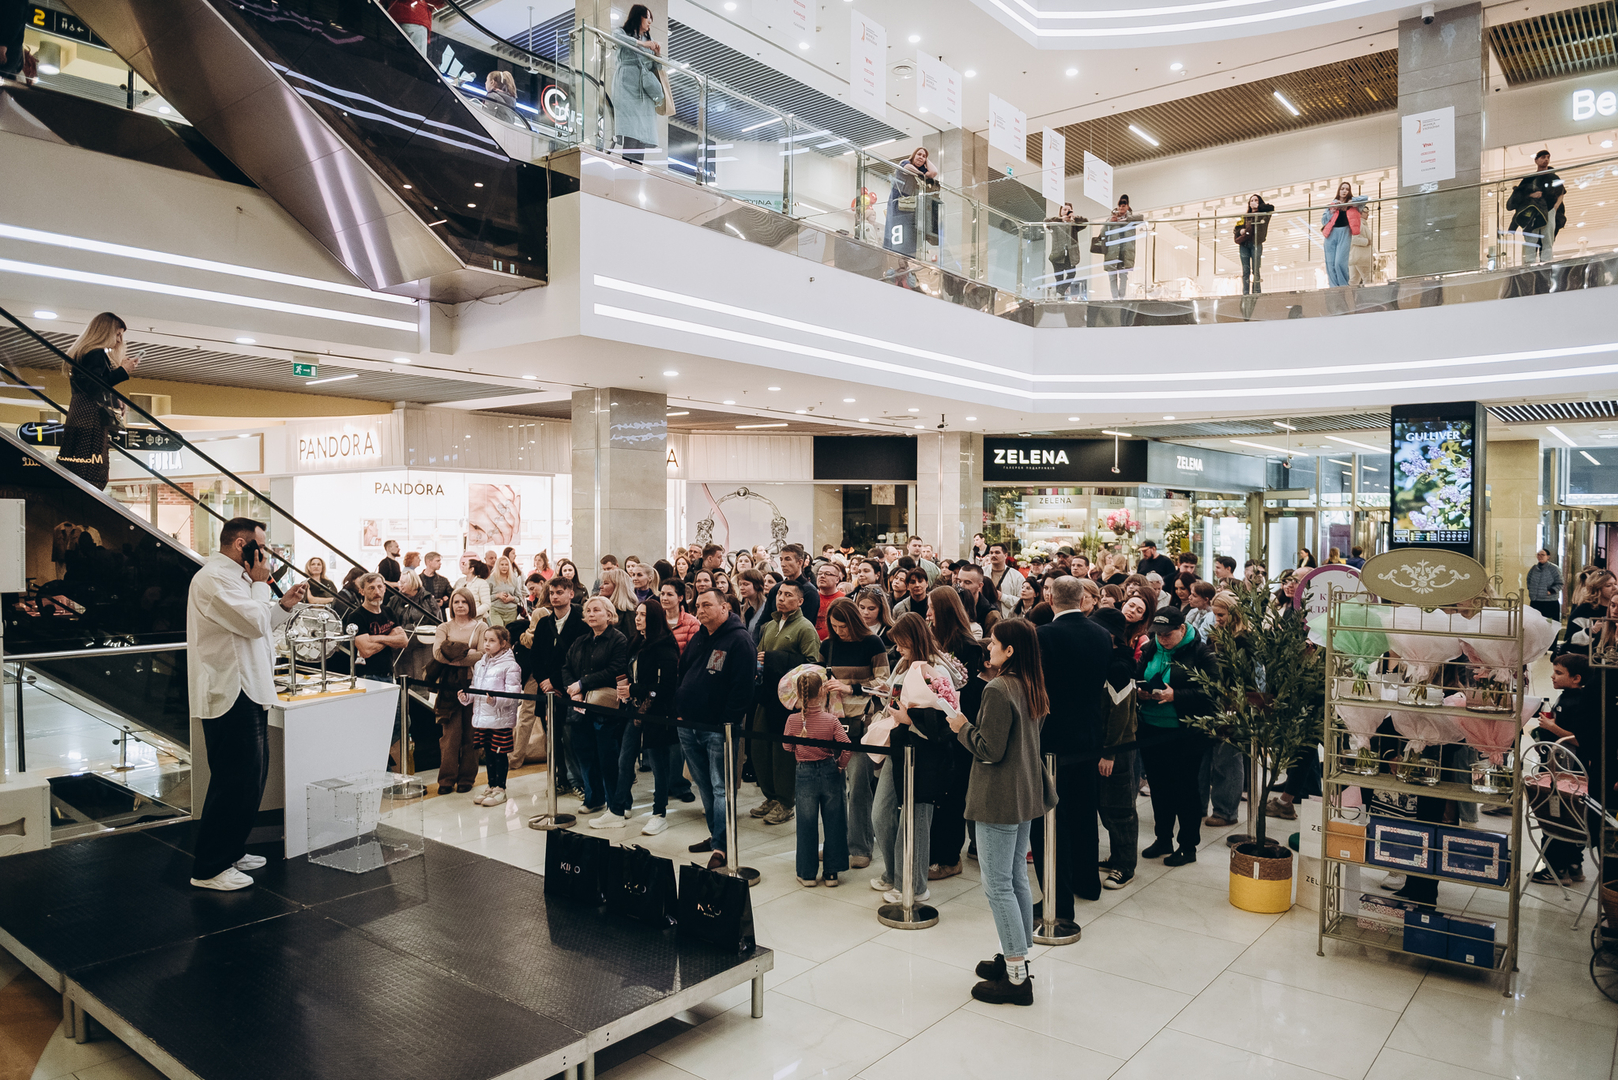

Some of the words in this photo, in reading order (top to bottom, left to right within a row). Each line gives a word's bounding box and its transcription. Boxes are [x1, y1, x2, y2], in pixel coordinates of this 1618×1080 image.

[33, 8, 46, 26] 2
[1572, 88, 1617, 121] Be
[1405, 430, 1461, 441] GULLIVER
[299, 431, 375, 461] PANDORA
[148, 451, 183, 470] FURLA
[993, 449, 1070, 465] ZELENA
[1176, 455, 1204, 472] ZELENA
[374, 481, 445, 496] PANDORA
